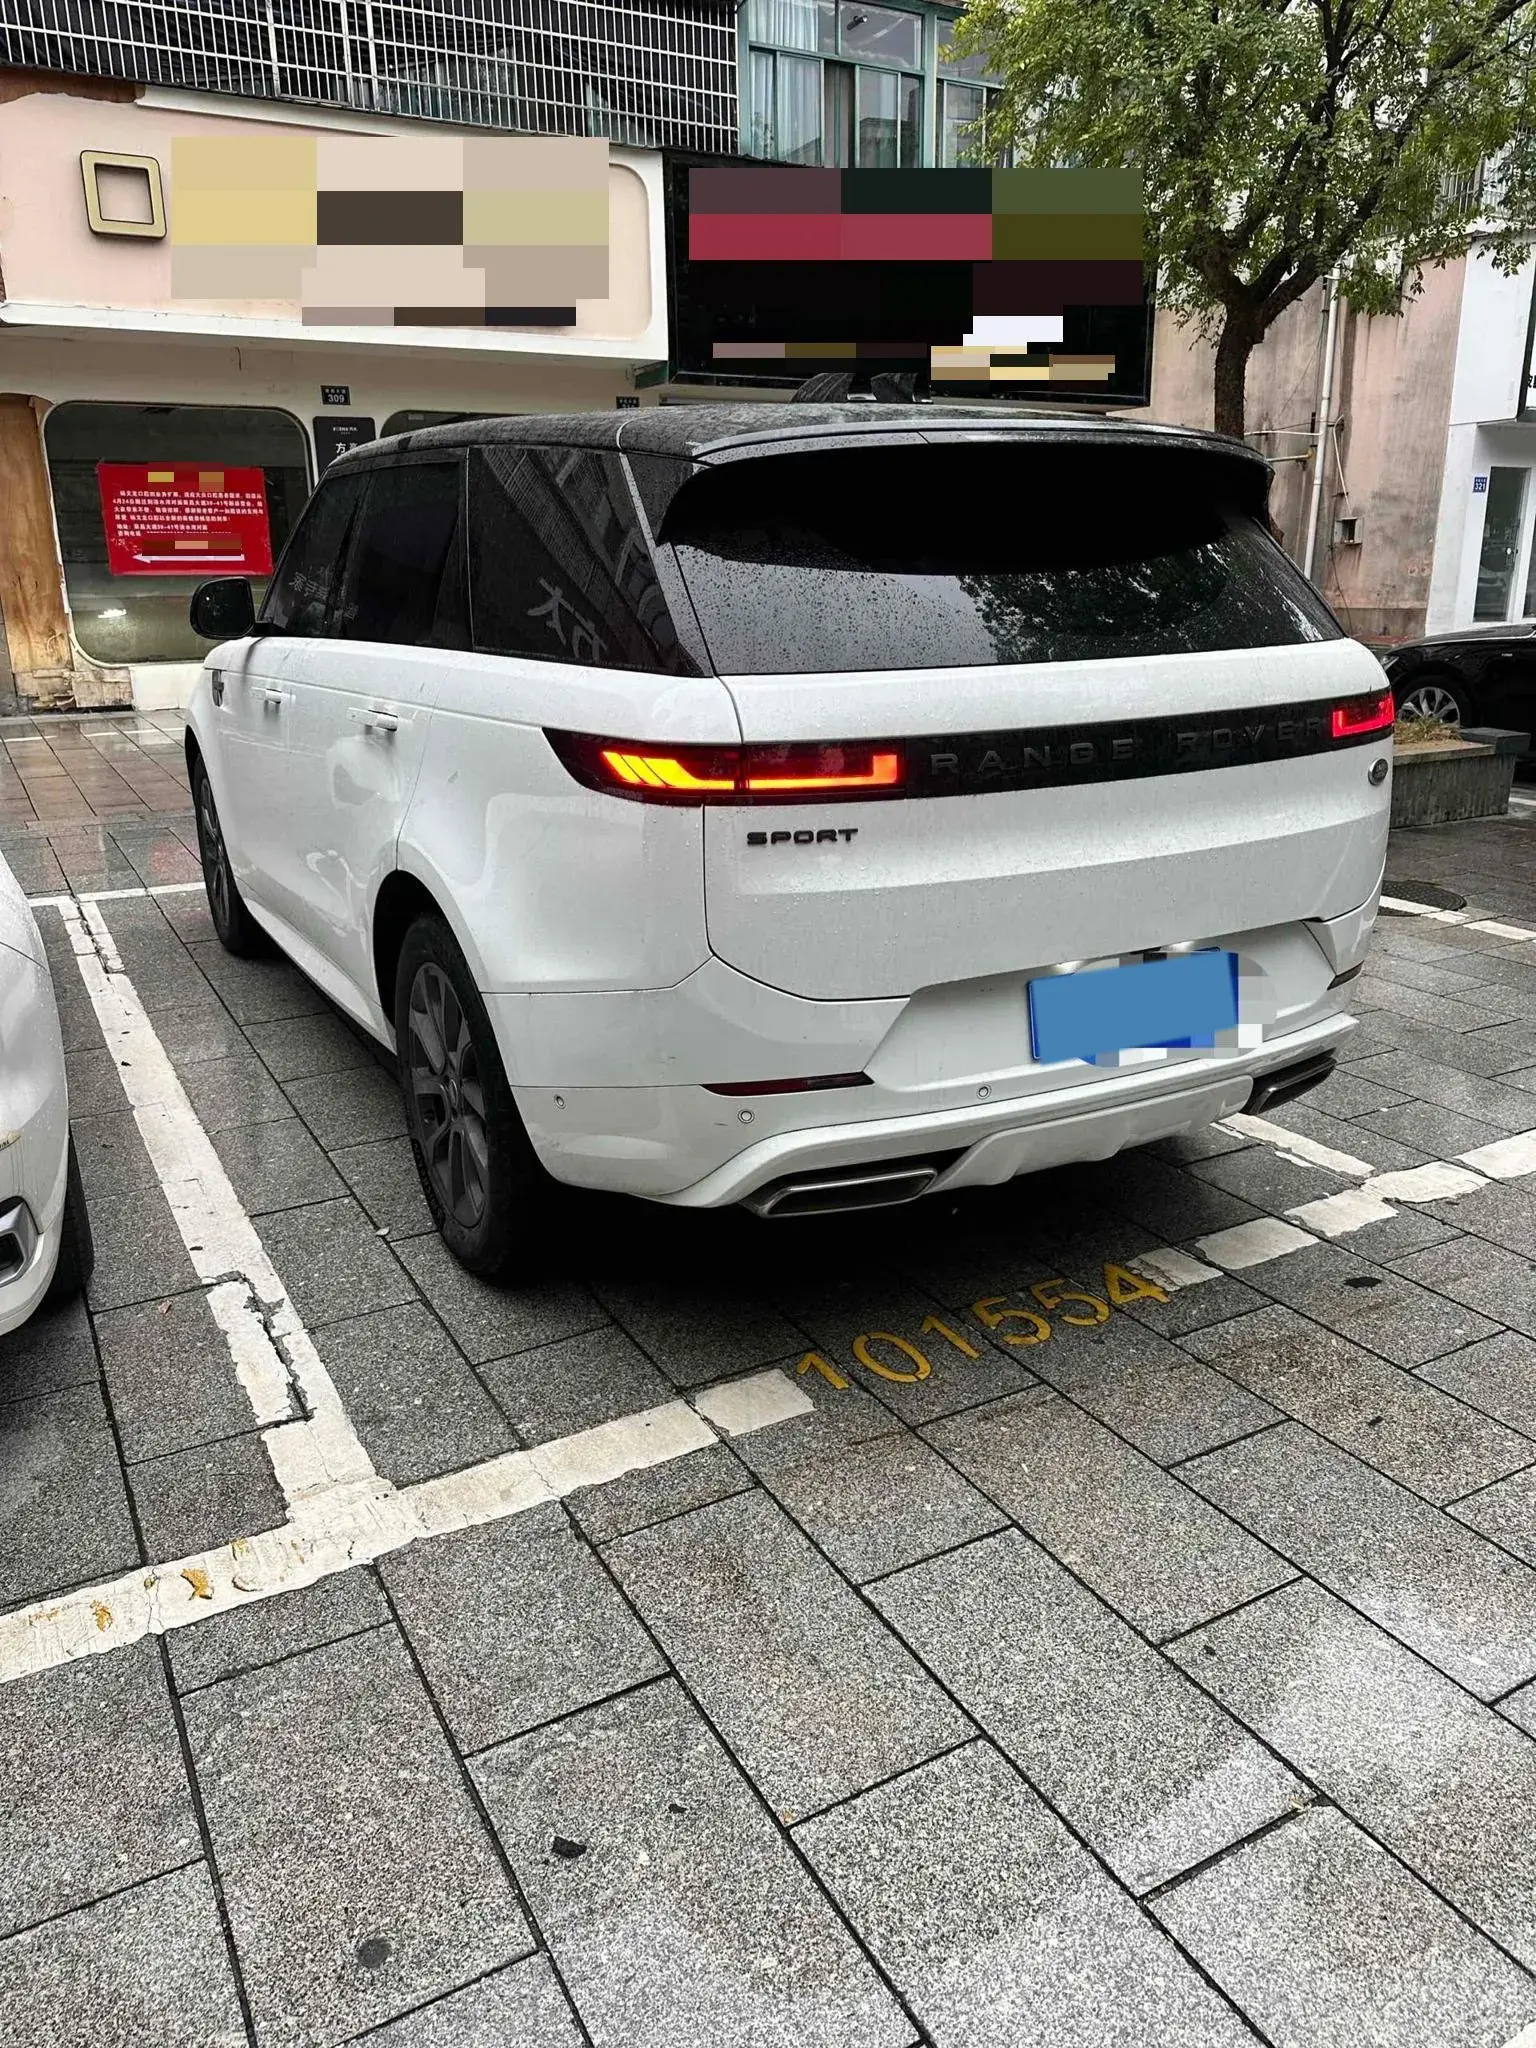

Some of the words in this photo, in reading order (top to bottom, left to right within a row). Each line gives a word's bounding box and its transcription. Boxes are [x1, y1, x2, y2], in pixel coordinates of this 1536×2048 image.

[327, 394, 345, 403] 309
[1474, 482, 1486, 490] 321
[930, 738, 1135, 776] RANGE
[1176, 719, 1323, 753] ROVER
[747, 828, 858, 845] SPORT
[796, 1263, 1171, 1391] 101554
